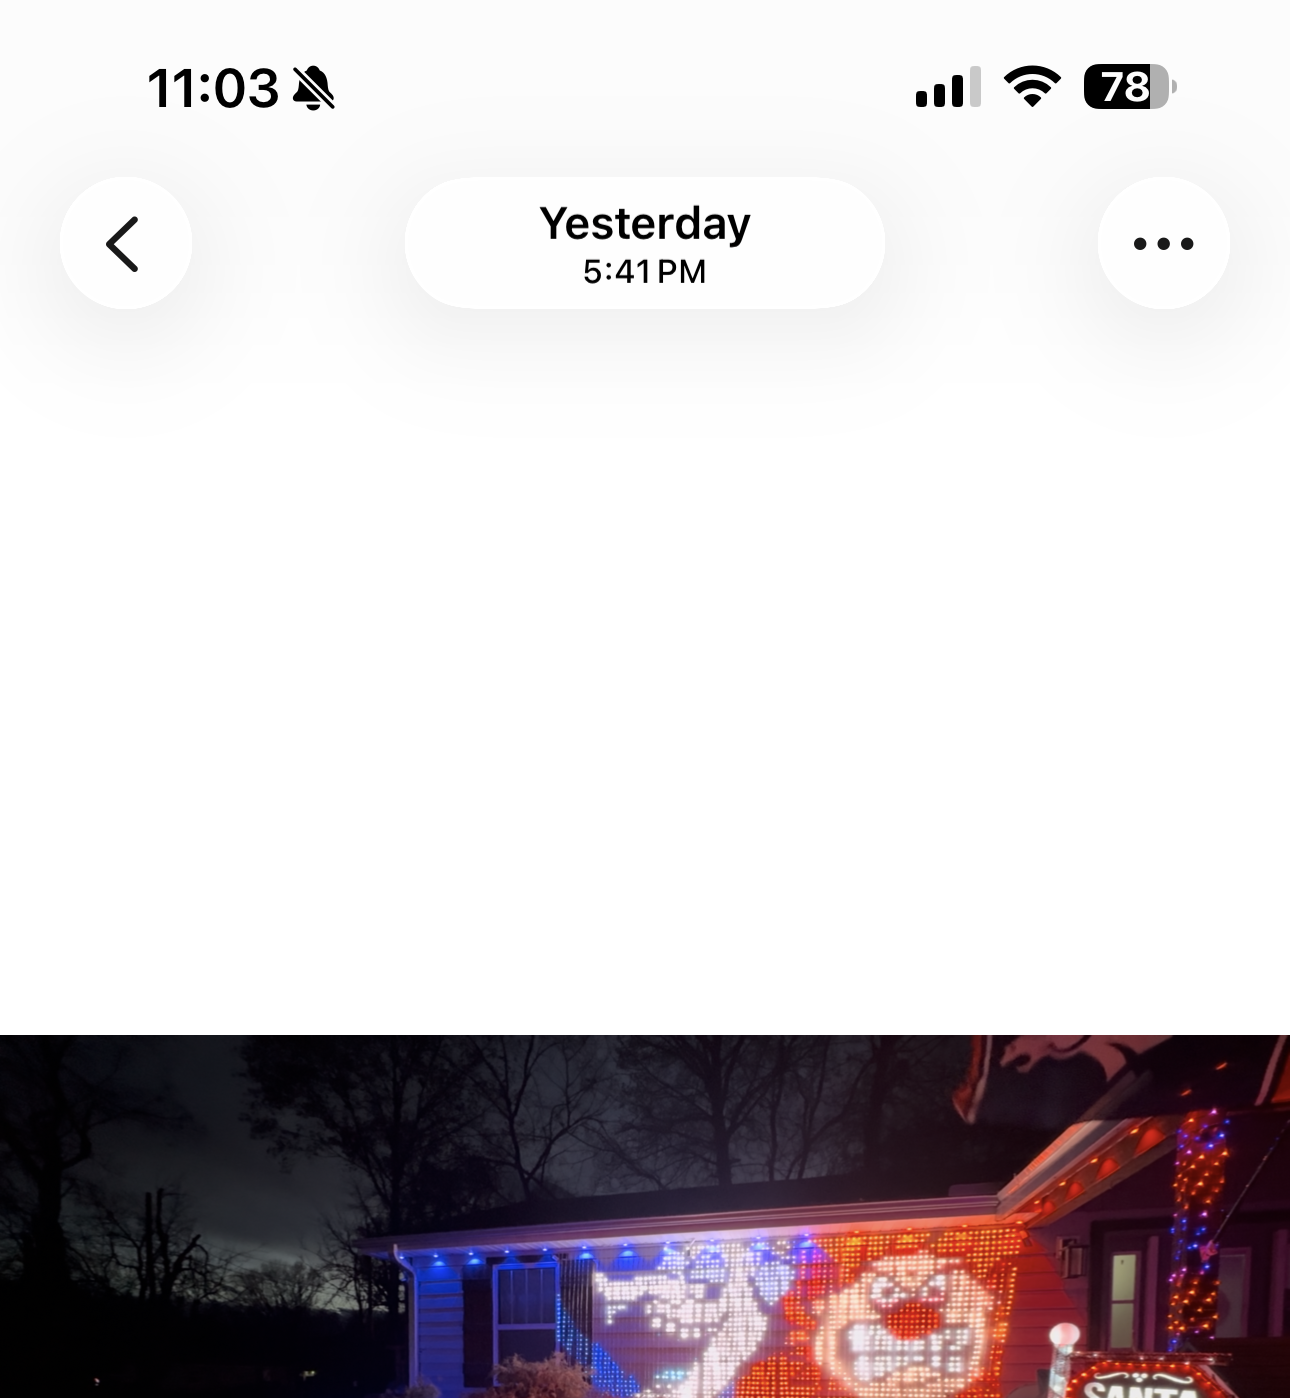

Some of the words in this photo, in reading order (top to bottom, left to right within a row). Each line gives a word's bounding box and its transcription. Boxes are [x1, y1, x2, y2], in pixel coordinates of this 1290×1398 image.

[148, 67, 279, 109] 11:03
[1101, 71, 1150, 102] 78
[539, 205, 751, 248] Yesterday
[584, 259, 648, 284] 5:41
[658, 258, 705, 284] PM
